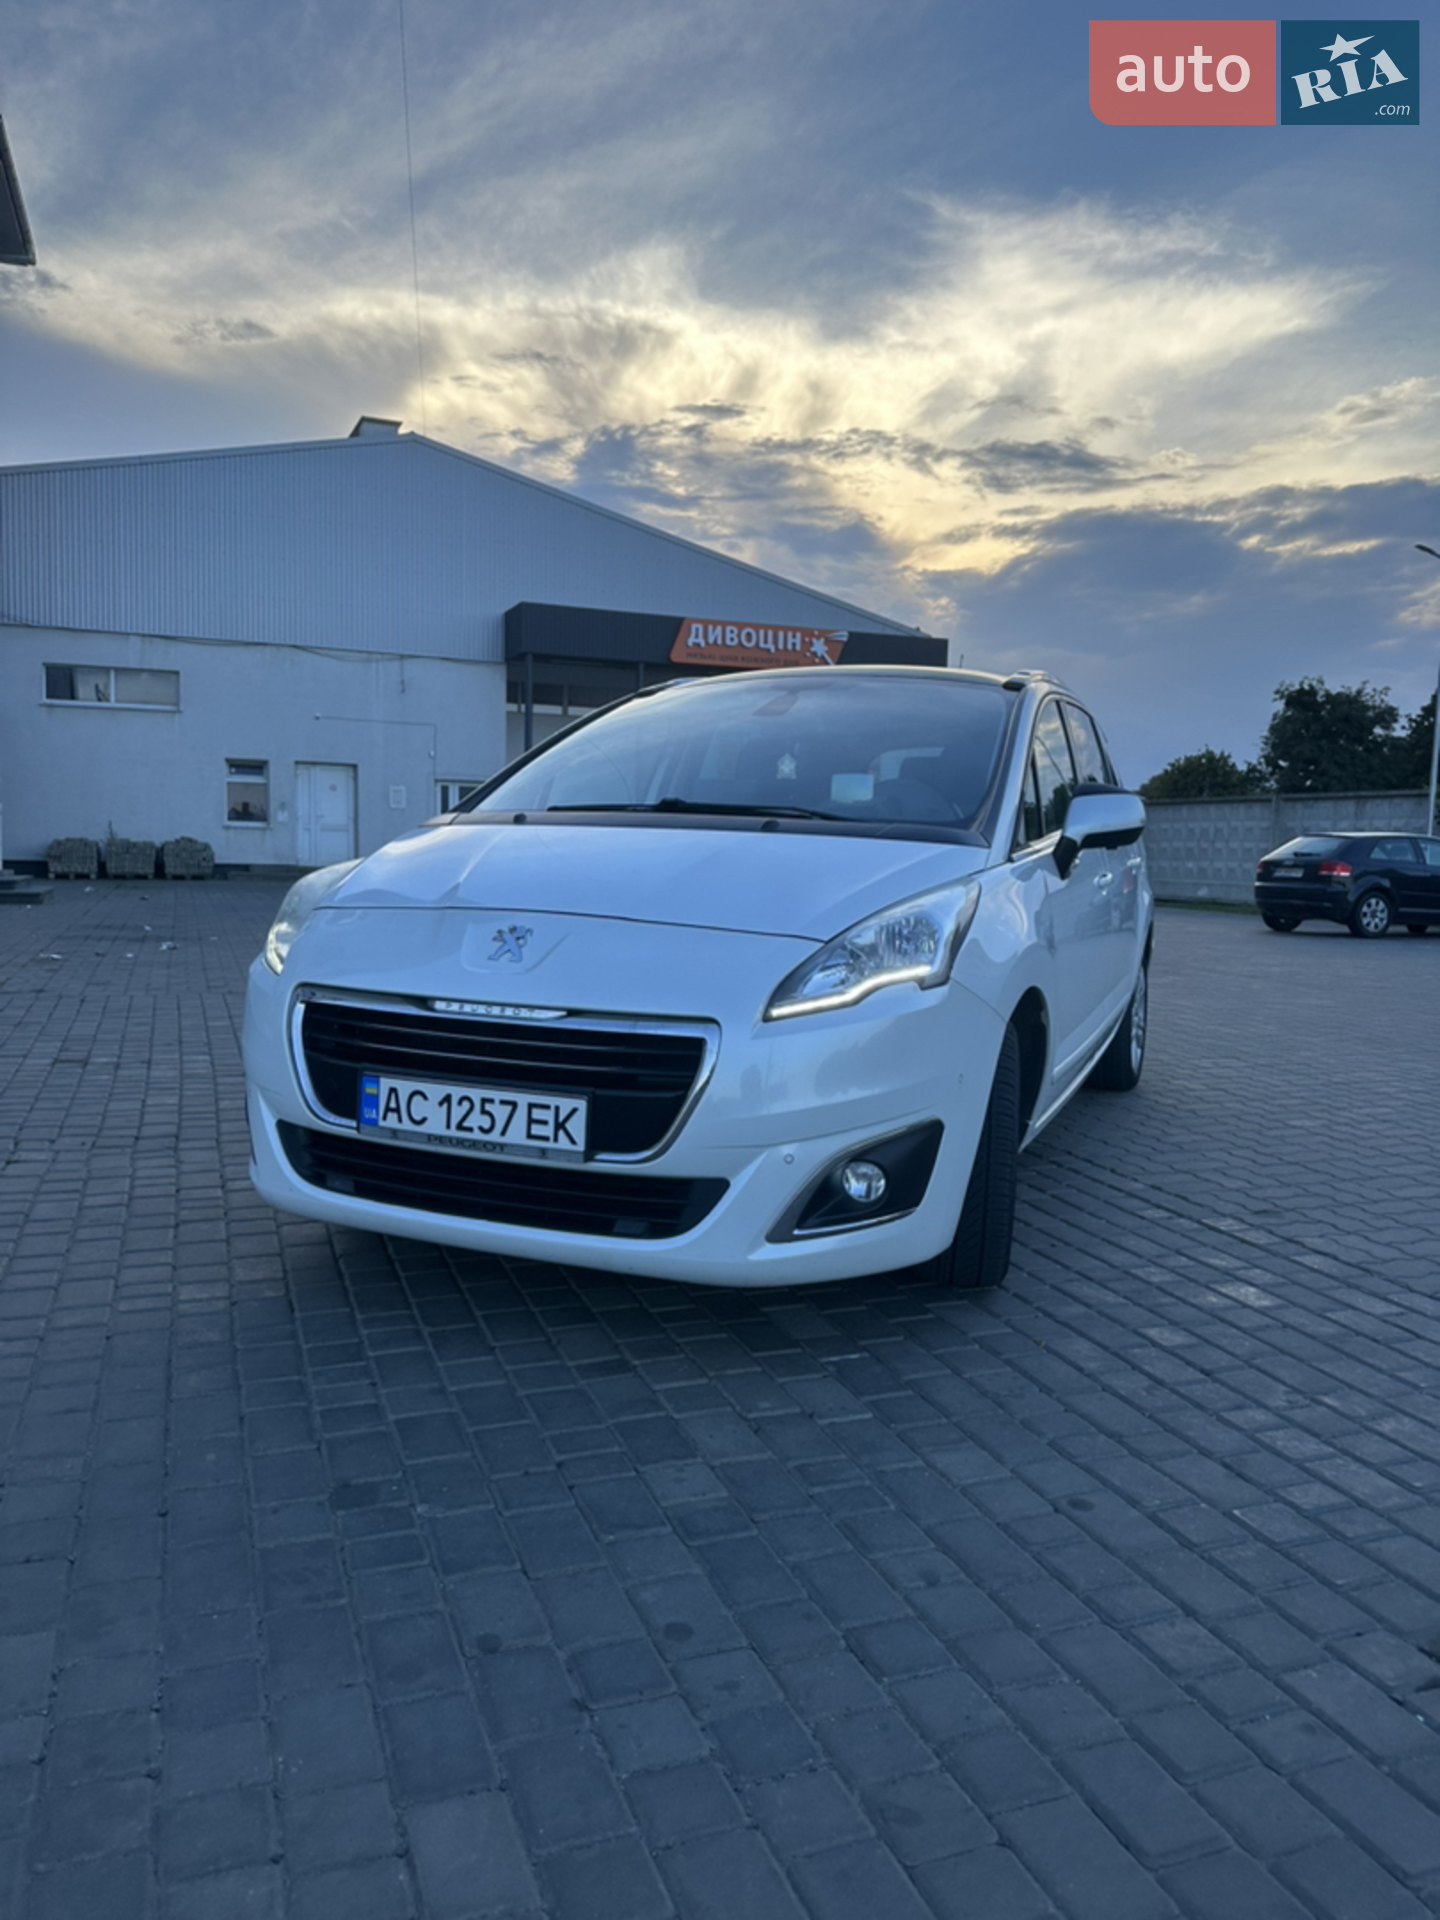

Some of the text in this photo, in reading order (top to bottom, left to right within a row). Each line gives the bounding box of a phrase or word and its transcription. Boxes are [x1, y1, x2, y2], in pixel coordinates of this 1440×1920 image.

[687, 623, 802, 654] ДИВОЦІН
[363, 1107, 378, 1120] UA
[381, 1086, 580, 1146] AC 1257 EK
[426, 1134, 506, 1154] PEUGEOT
